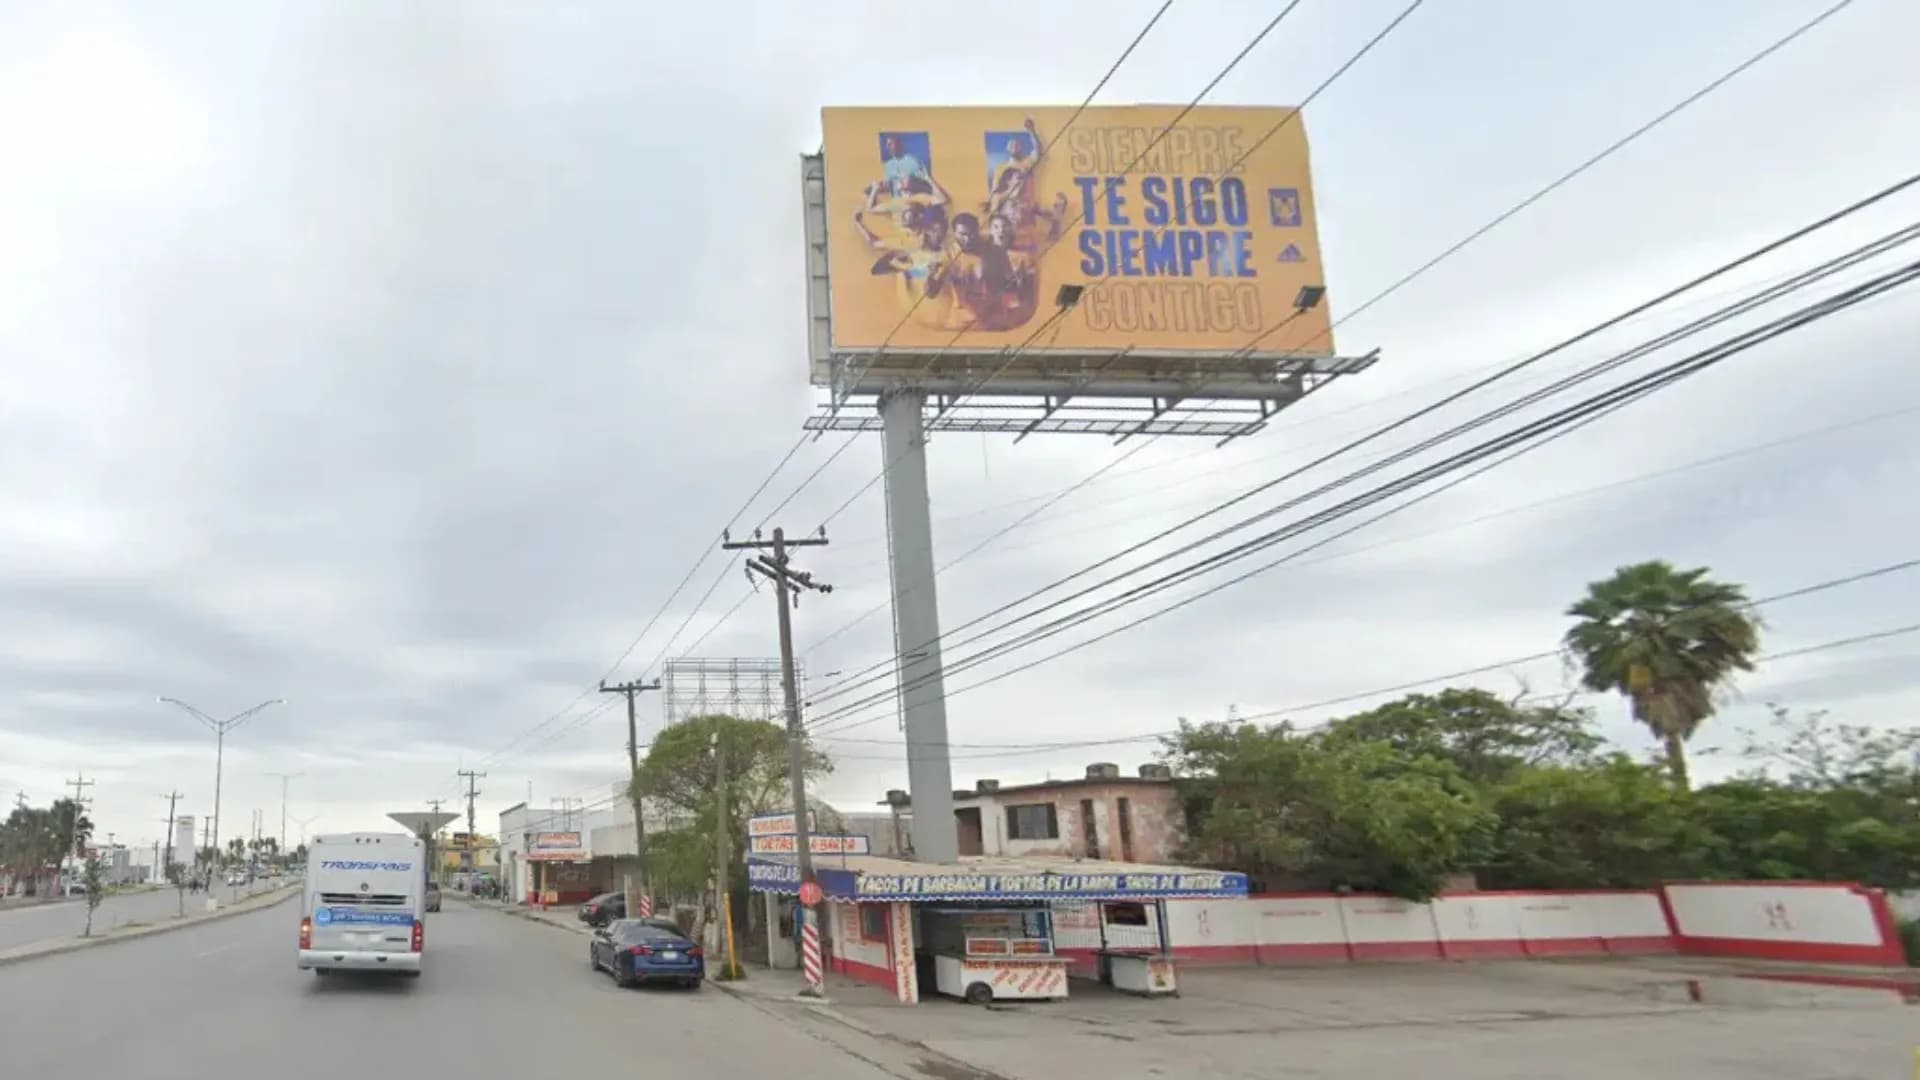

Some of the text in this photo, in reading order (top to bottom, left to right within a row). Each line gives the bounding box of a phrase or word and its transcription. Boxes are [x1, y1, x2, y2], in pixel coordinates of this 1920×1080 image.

[1070, 126, 1244, 175] SIEMPRE
[1074, 175, 1249, 226] TE SIGO
[1078, 230, 1257, 279] SIEMPRE
[1083, 282, 1263, 334] CONTIGO
[857, 874, 901, 894] TACOS
